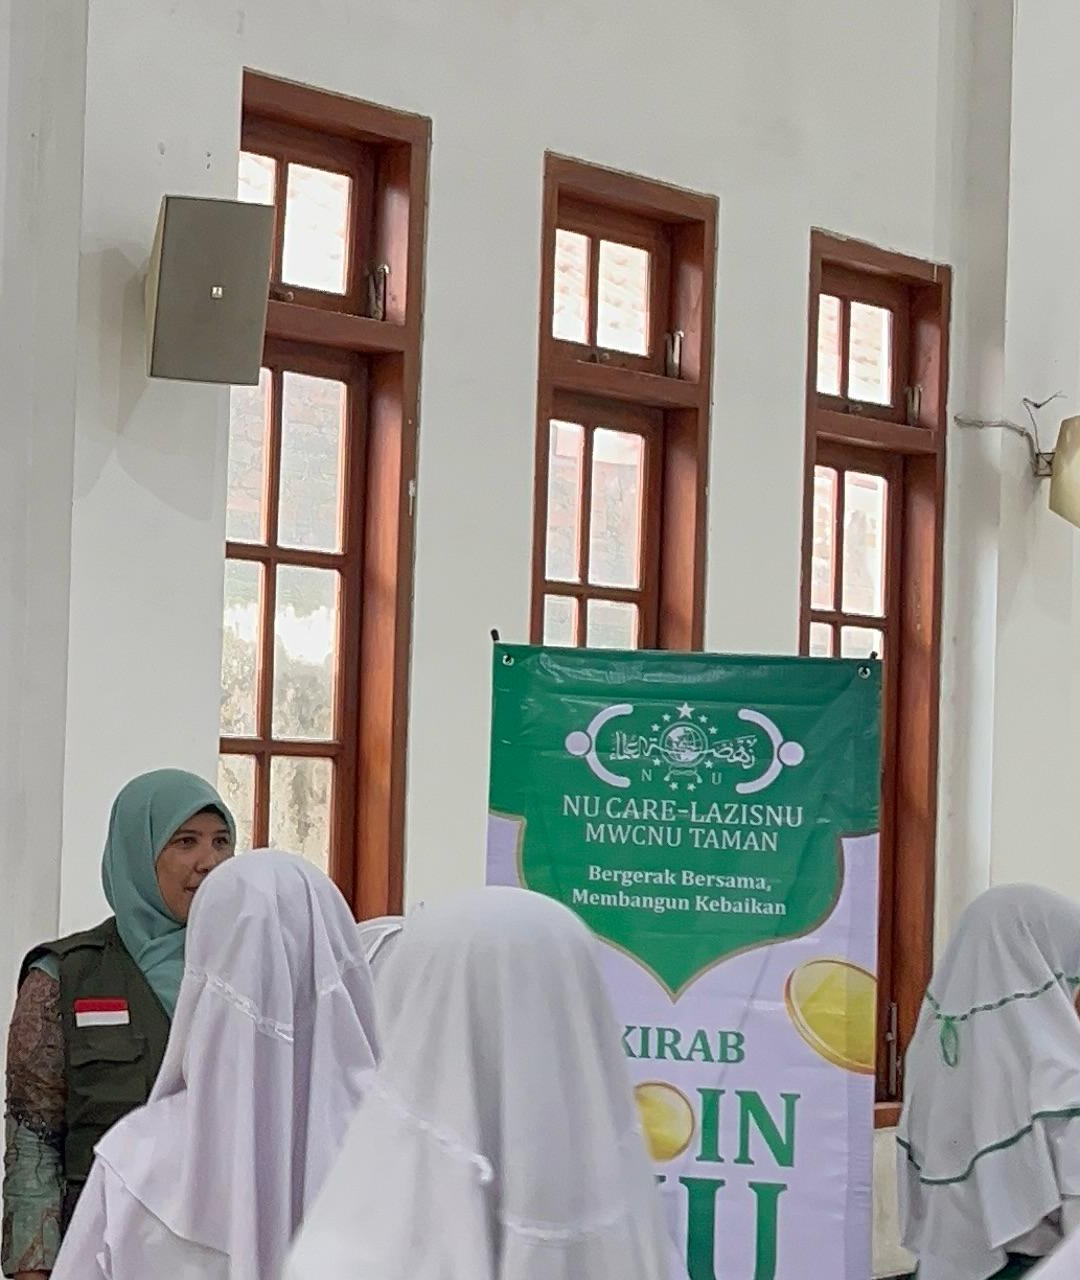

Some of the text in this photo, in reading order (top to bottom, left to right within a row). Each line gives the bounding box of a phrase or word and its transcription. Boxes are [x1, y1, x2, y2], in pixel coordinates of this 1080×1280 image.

[562, 794, 804, 828] NU CARE-LAZISNU
[585, 822, 779, 852] MWCNU TAMAN
[588, 864, 772, 892] Bergerak Bersama,
[572, 888, 787, 916] Membangun Kebaikan
[695, 1086, 801, 1168] IN
